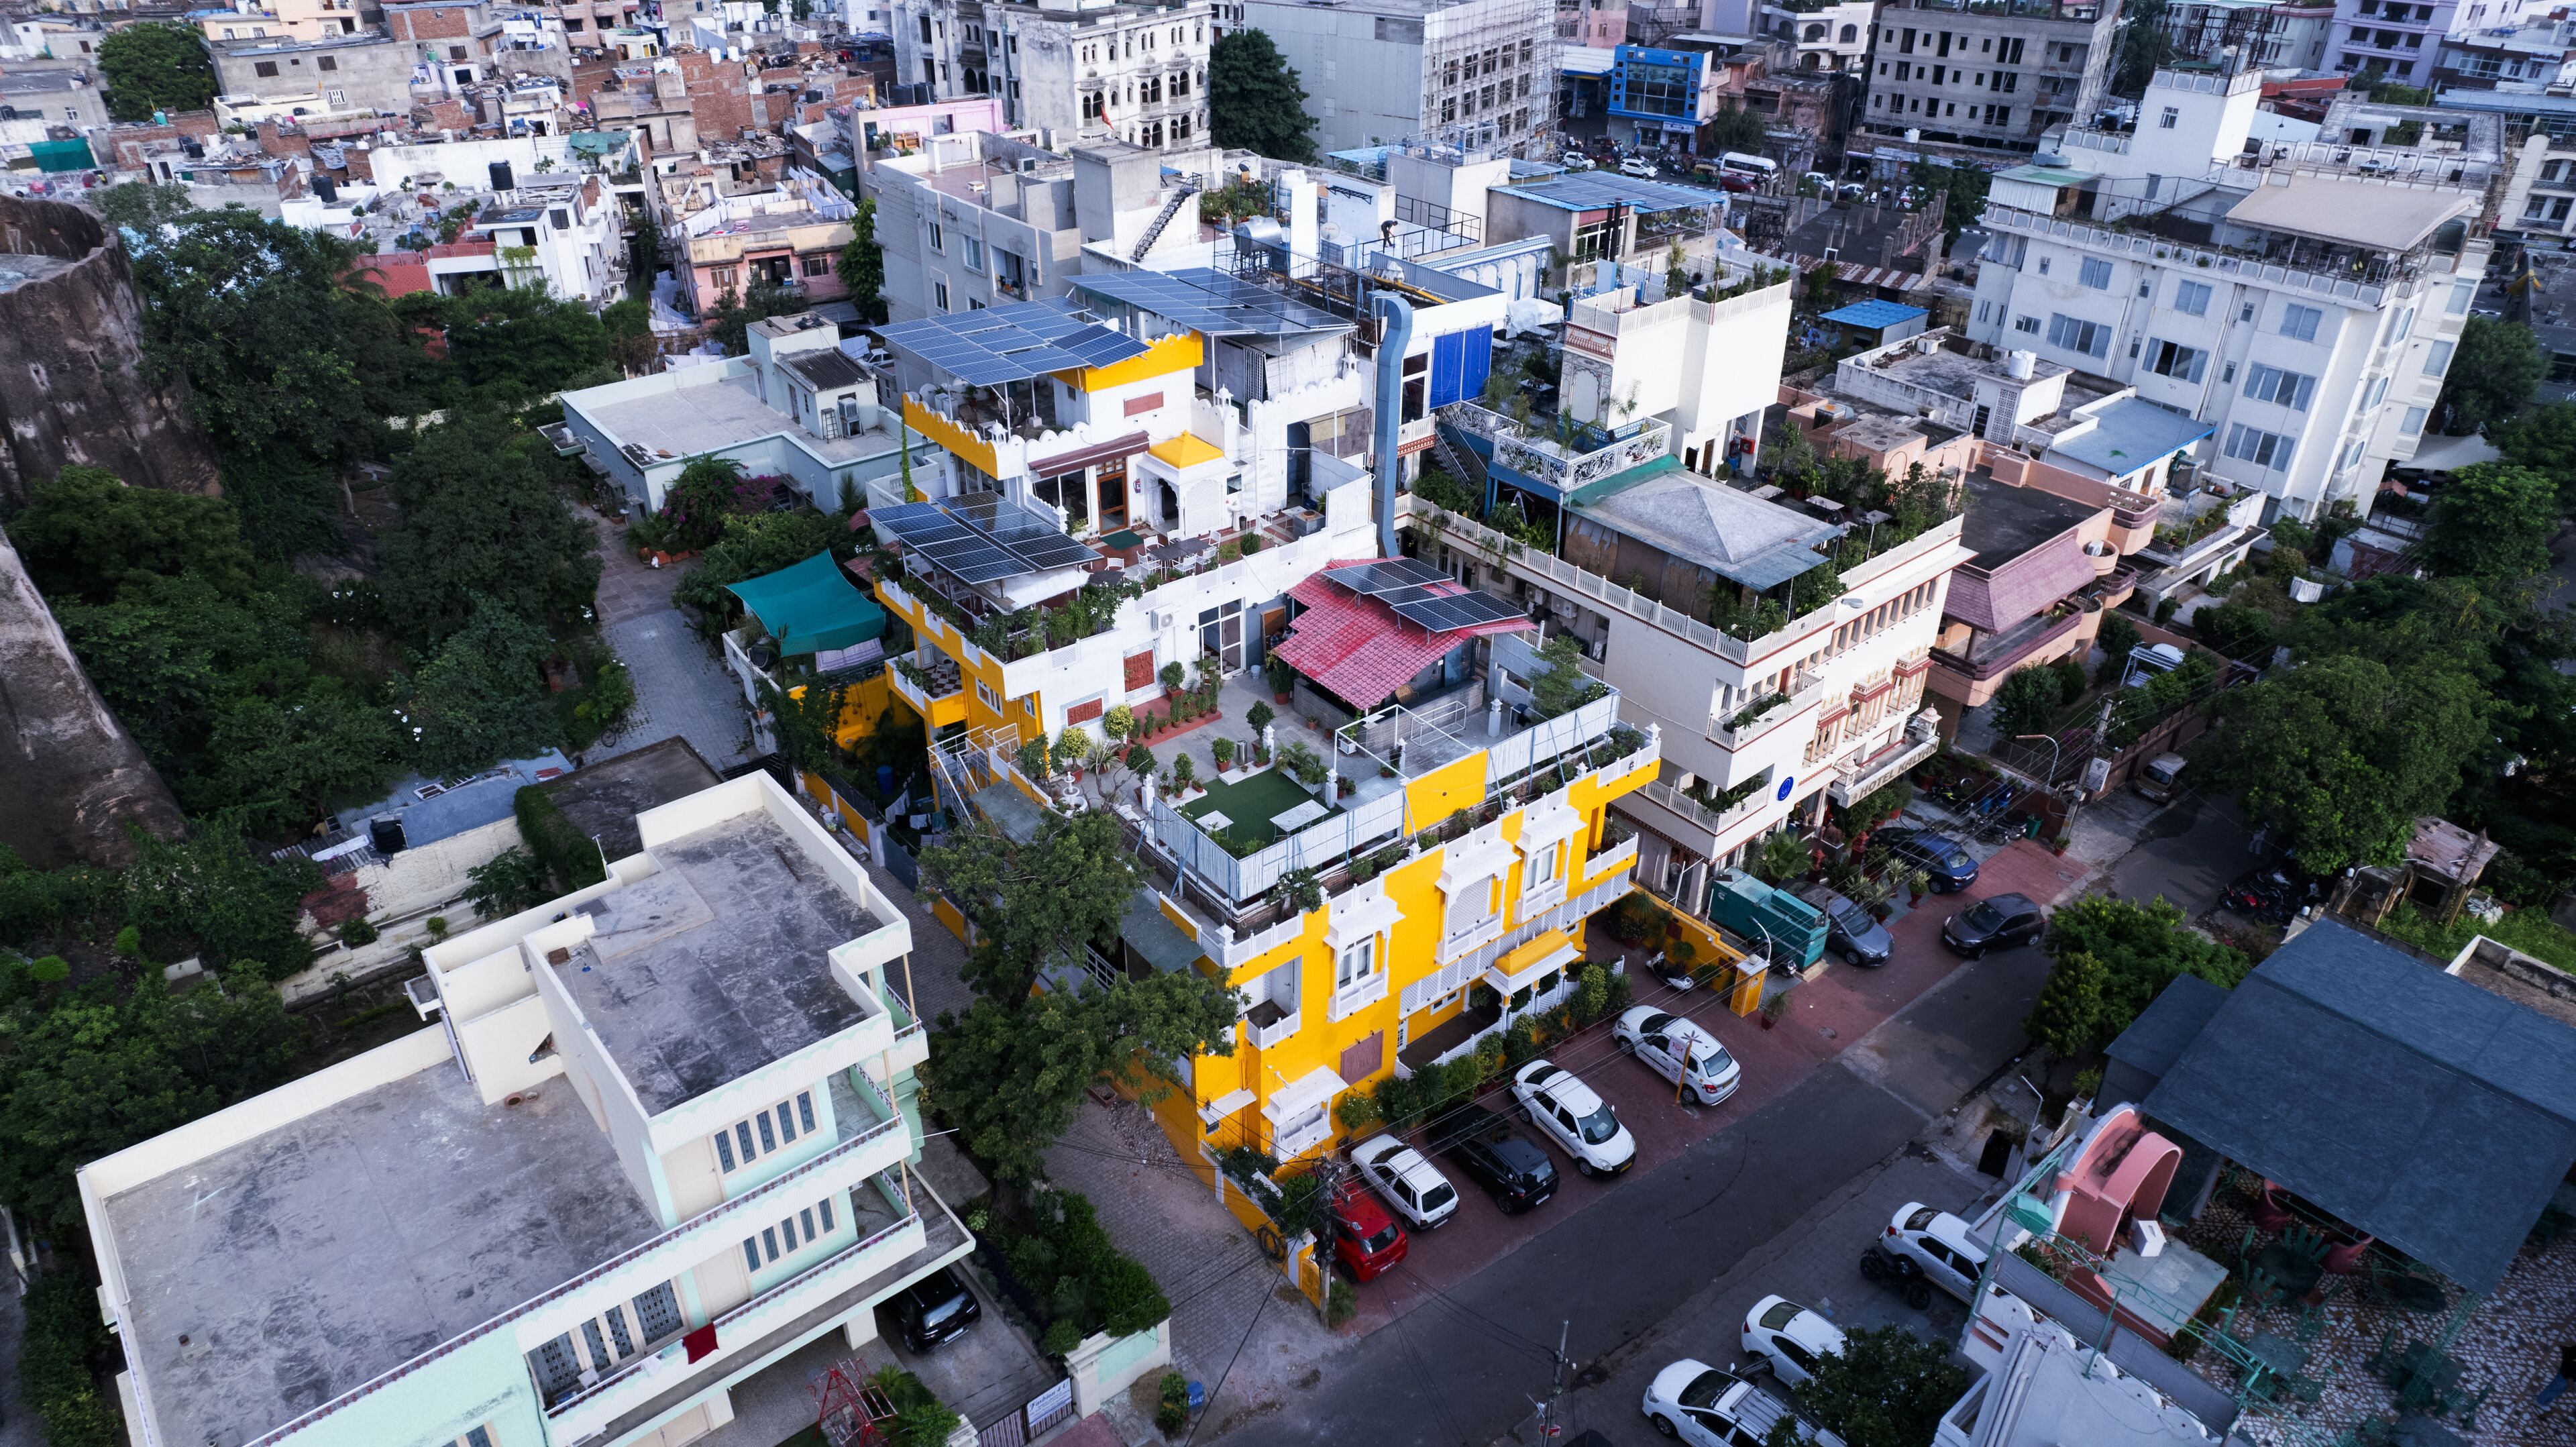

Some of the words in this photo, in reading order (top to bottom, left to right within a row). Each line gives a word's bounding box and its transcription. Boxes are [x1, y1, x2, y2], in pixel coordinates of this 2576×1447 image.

[1860, 769, 1894, 798] HOTEL
[1898, 741, 1938, 773] KALYAN
[1029, 1391, 1055, 1411] Fashion
